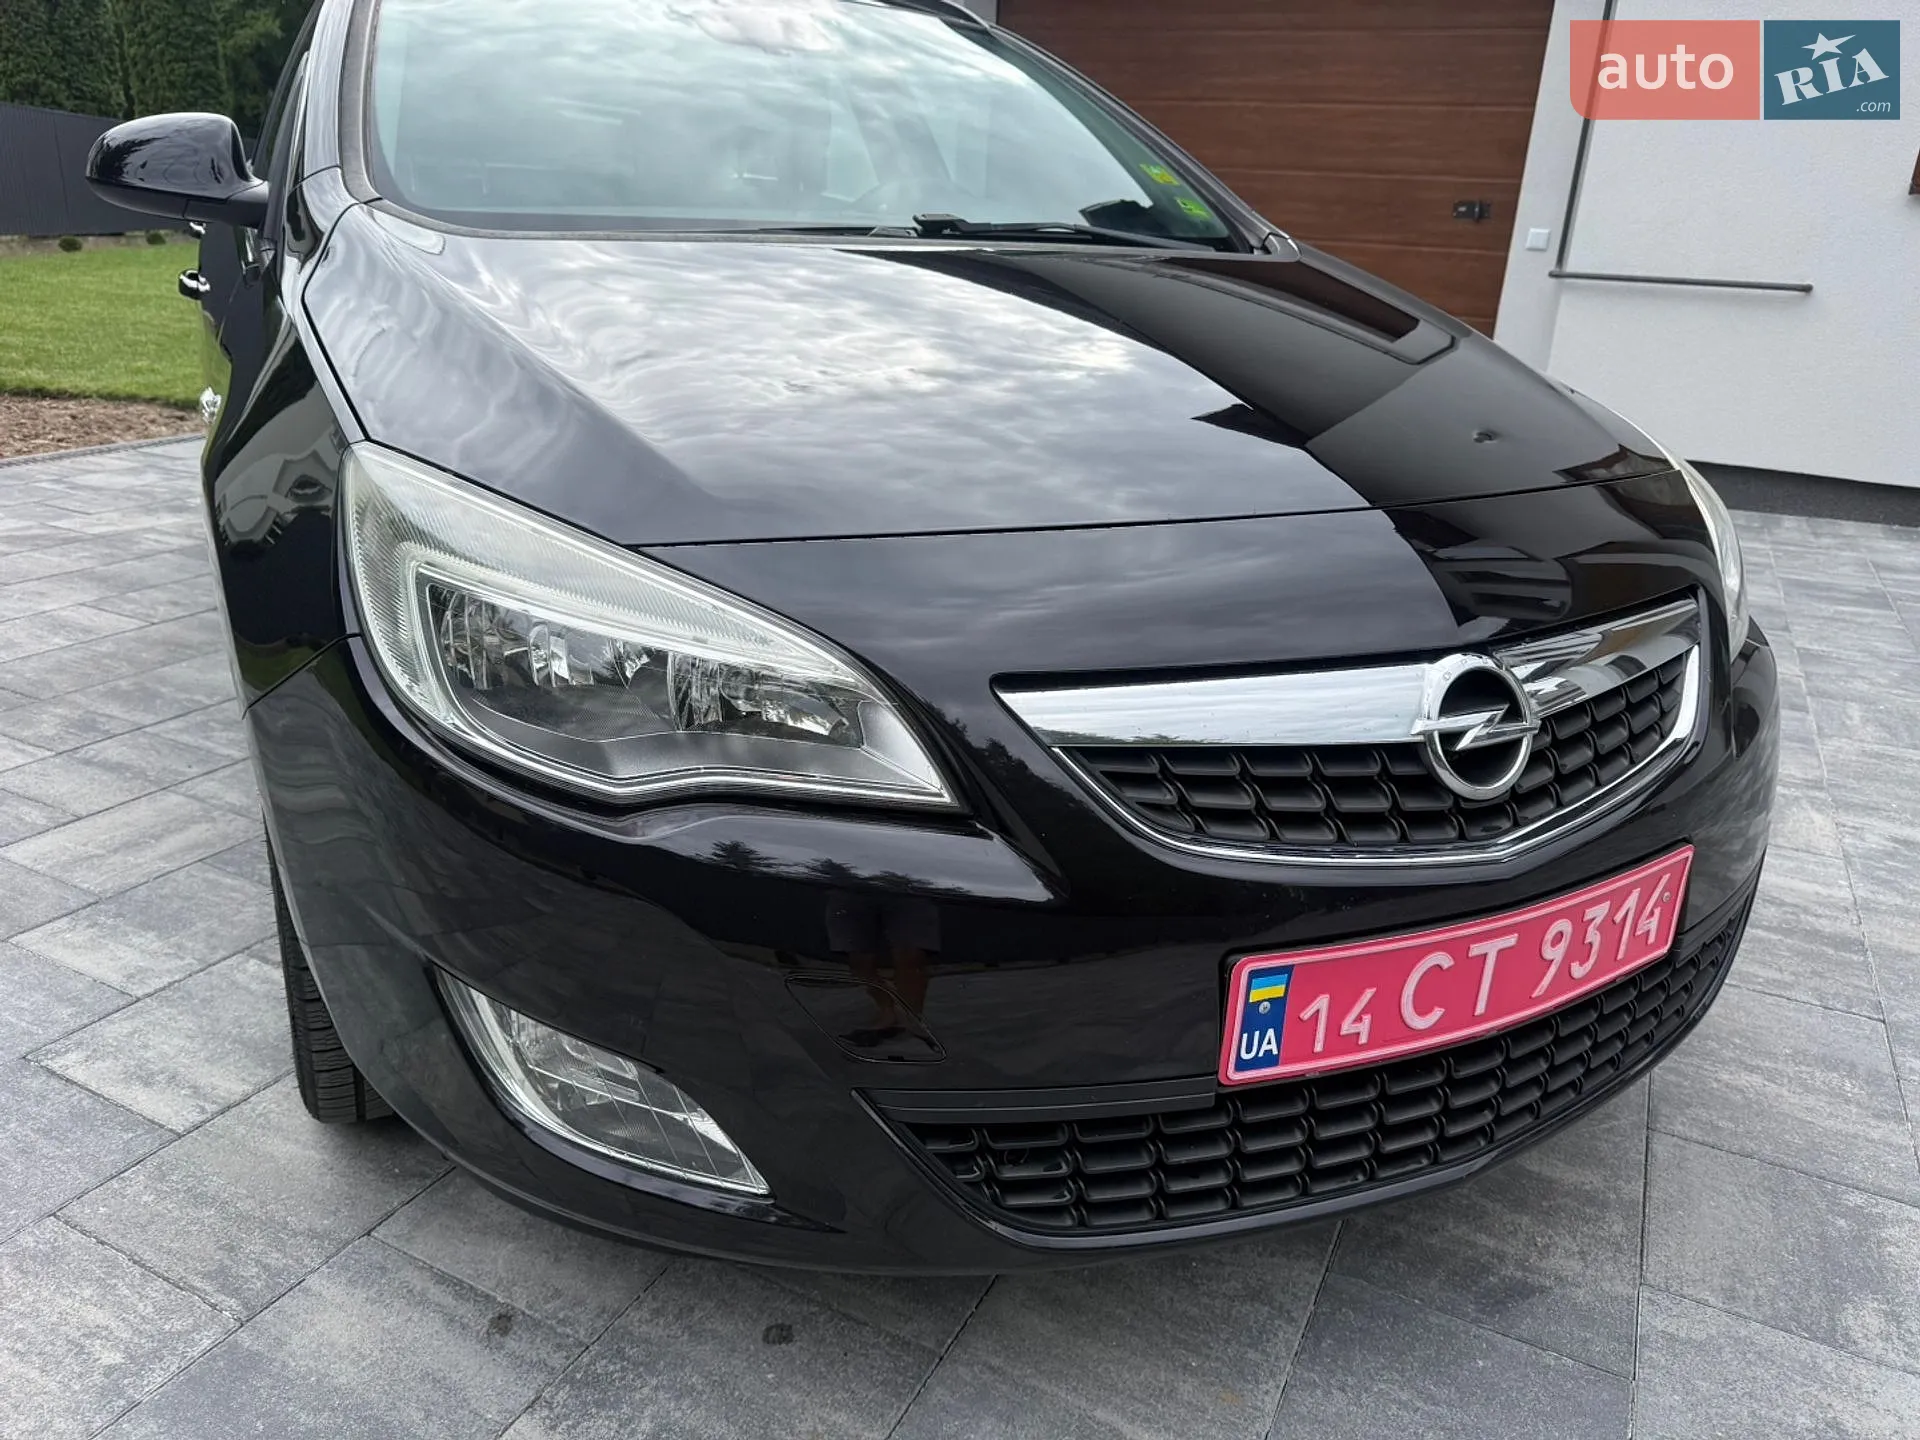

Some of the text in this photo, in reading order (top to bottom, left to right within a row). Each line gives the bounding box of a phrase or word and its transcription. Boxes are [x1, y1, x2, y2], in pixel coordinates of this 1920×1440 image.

[1299, 873, 1671, 1053] 14 CT 9314
[1240, 1032, 1278, 1060] UA
